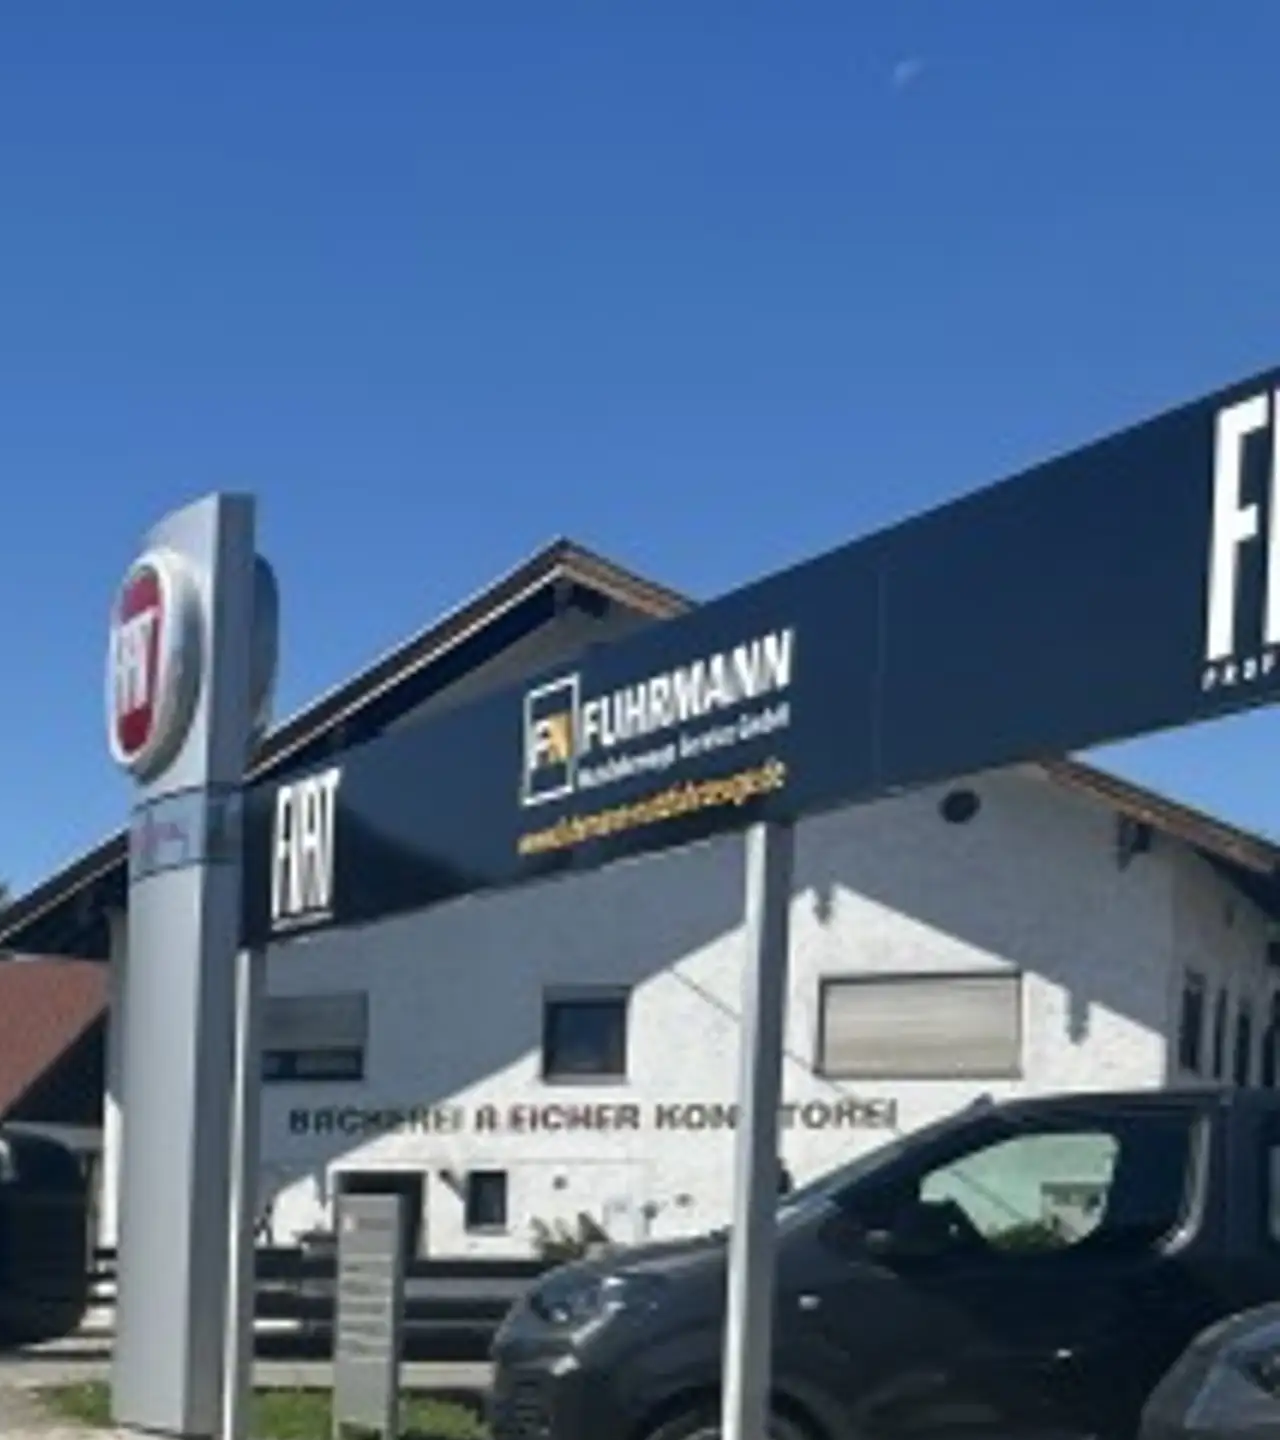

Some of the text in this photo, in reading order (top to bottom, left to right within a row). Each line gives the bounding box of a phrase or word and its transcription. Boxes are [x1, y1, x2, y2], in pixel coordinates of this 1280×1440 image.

[112, 606, 158, 708] FIAT
[579, 629, 793, 752] FUHRMANN
[271, 767, 340, 921] FIAT
